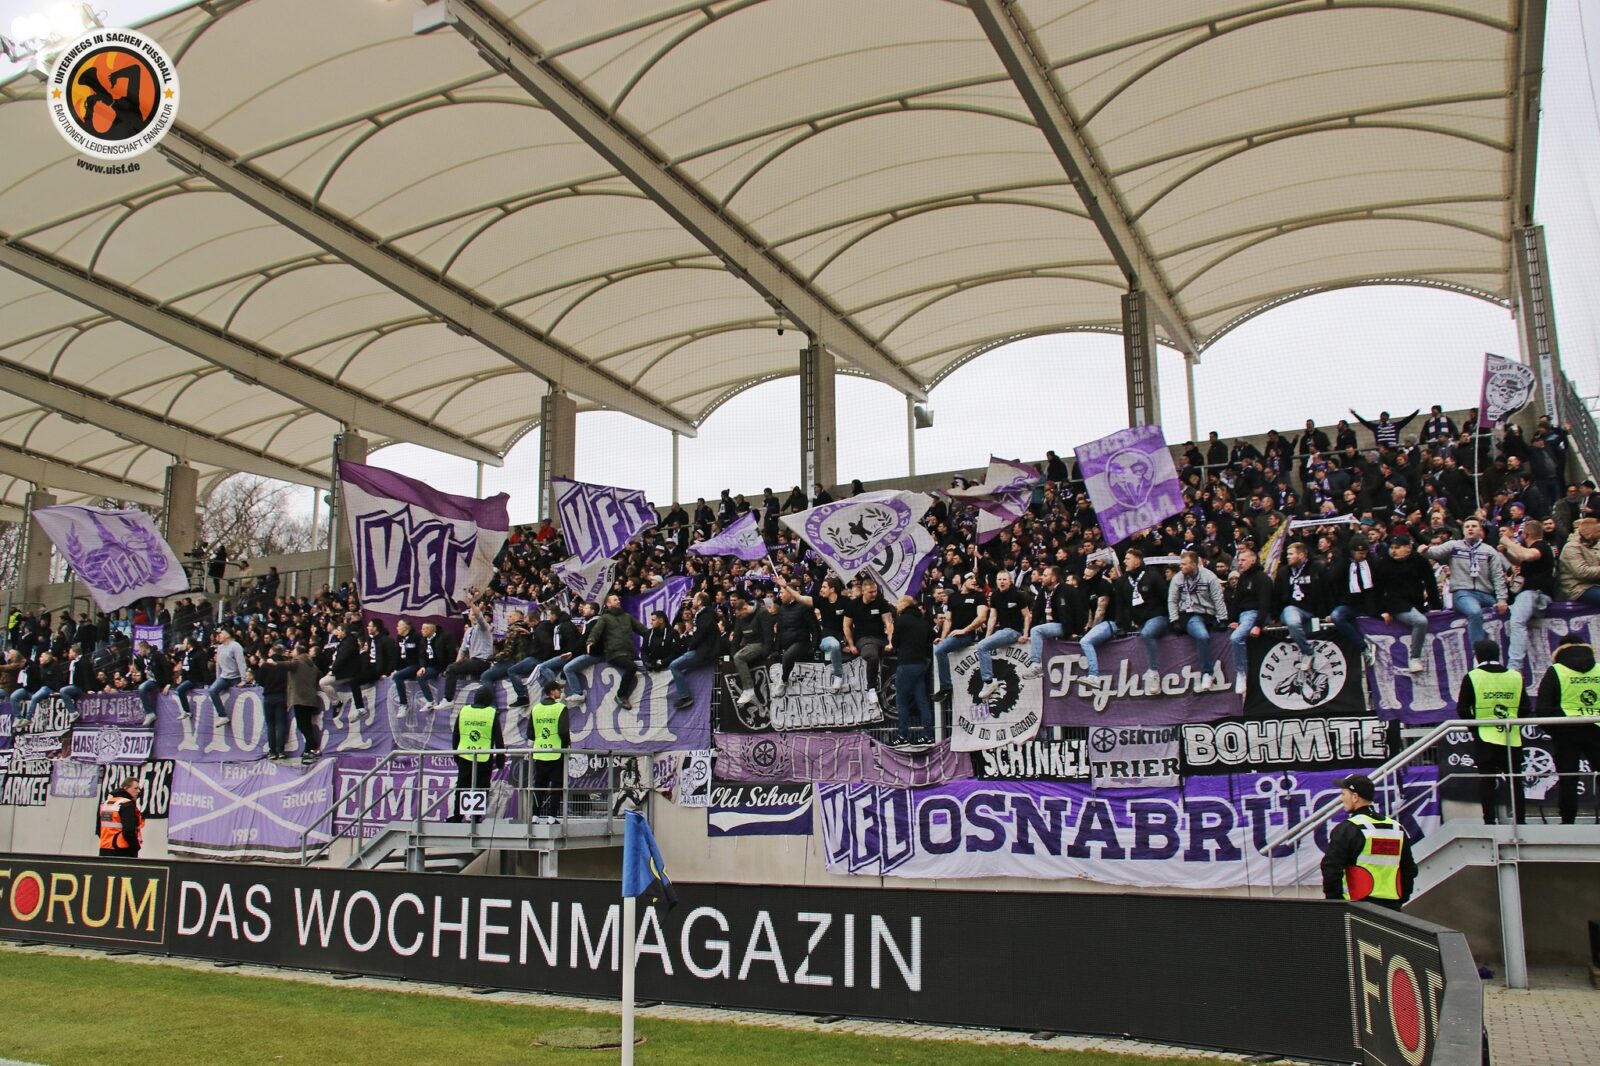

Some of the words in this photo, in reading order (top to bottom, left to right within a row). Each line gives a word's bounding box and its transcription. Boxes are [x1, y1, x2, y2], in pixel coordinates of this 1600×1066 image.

[1312, 640, 1344, 677] TEXAS
[958, 716, 975, 735] ALL
[1119, 727, 1180, 747] SEKTION
[122, 735, 153, 754] STADT
[1183, 716, 1390, 767] BOHMTE
[983, 740, 1090, 778] SCHINKEL
[1091, 757, 1180, 779] TRIER
[3, 776, 49, 806] ARMEE
[170, 792, 215, 811] BREMER
[460, 792, 485, 812] C2
[710, 786, 741, 808] Old
[745, 783, 814, 808] School
[177, 880, 272, 943] DAS
[293, 886, 922, 992] WOCHENMAGAZIN
